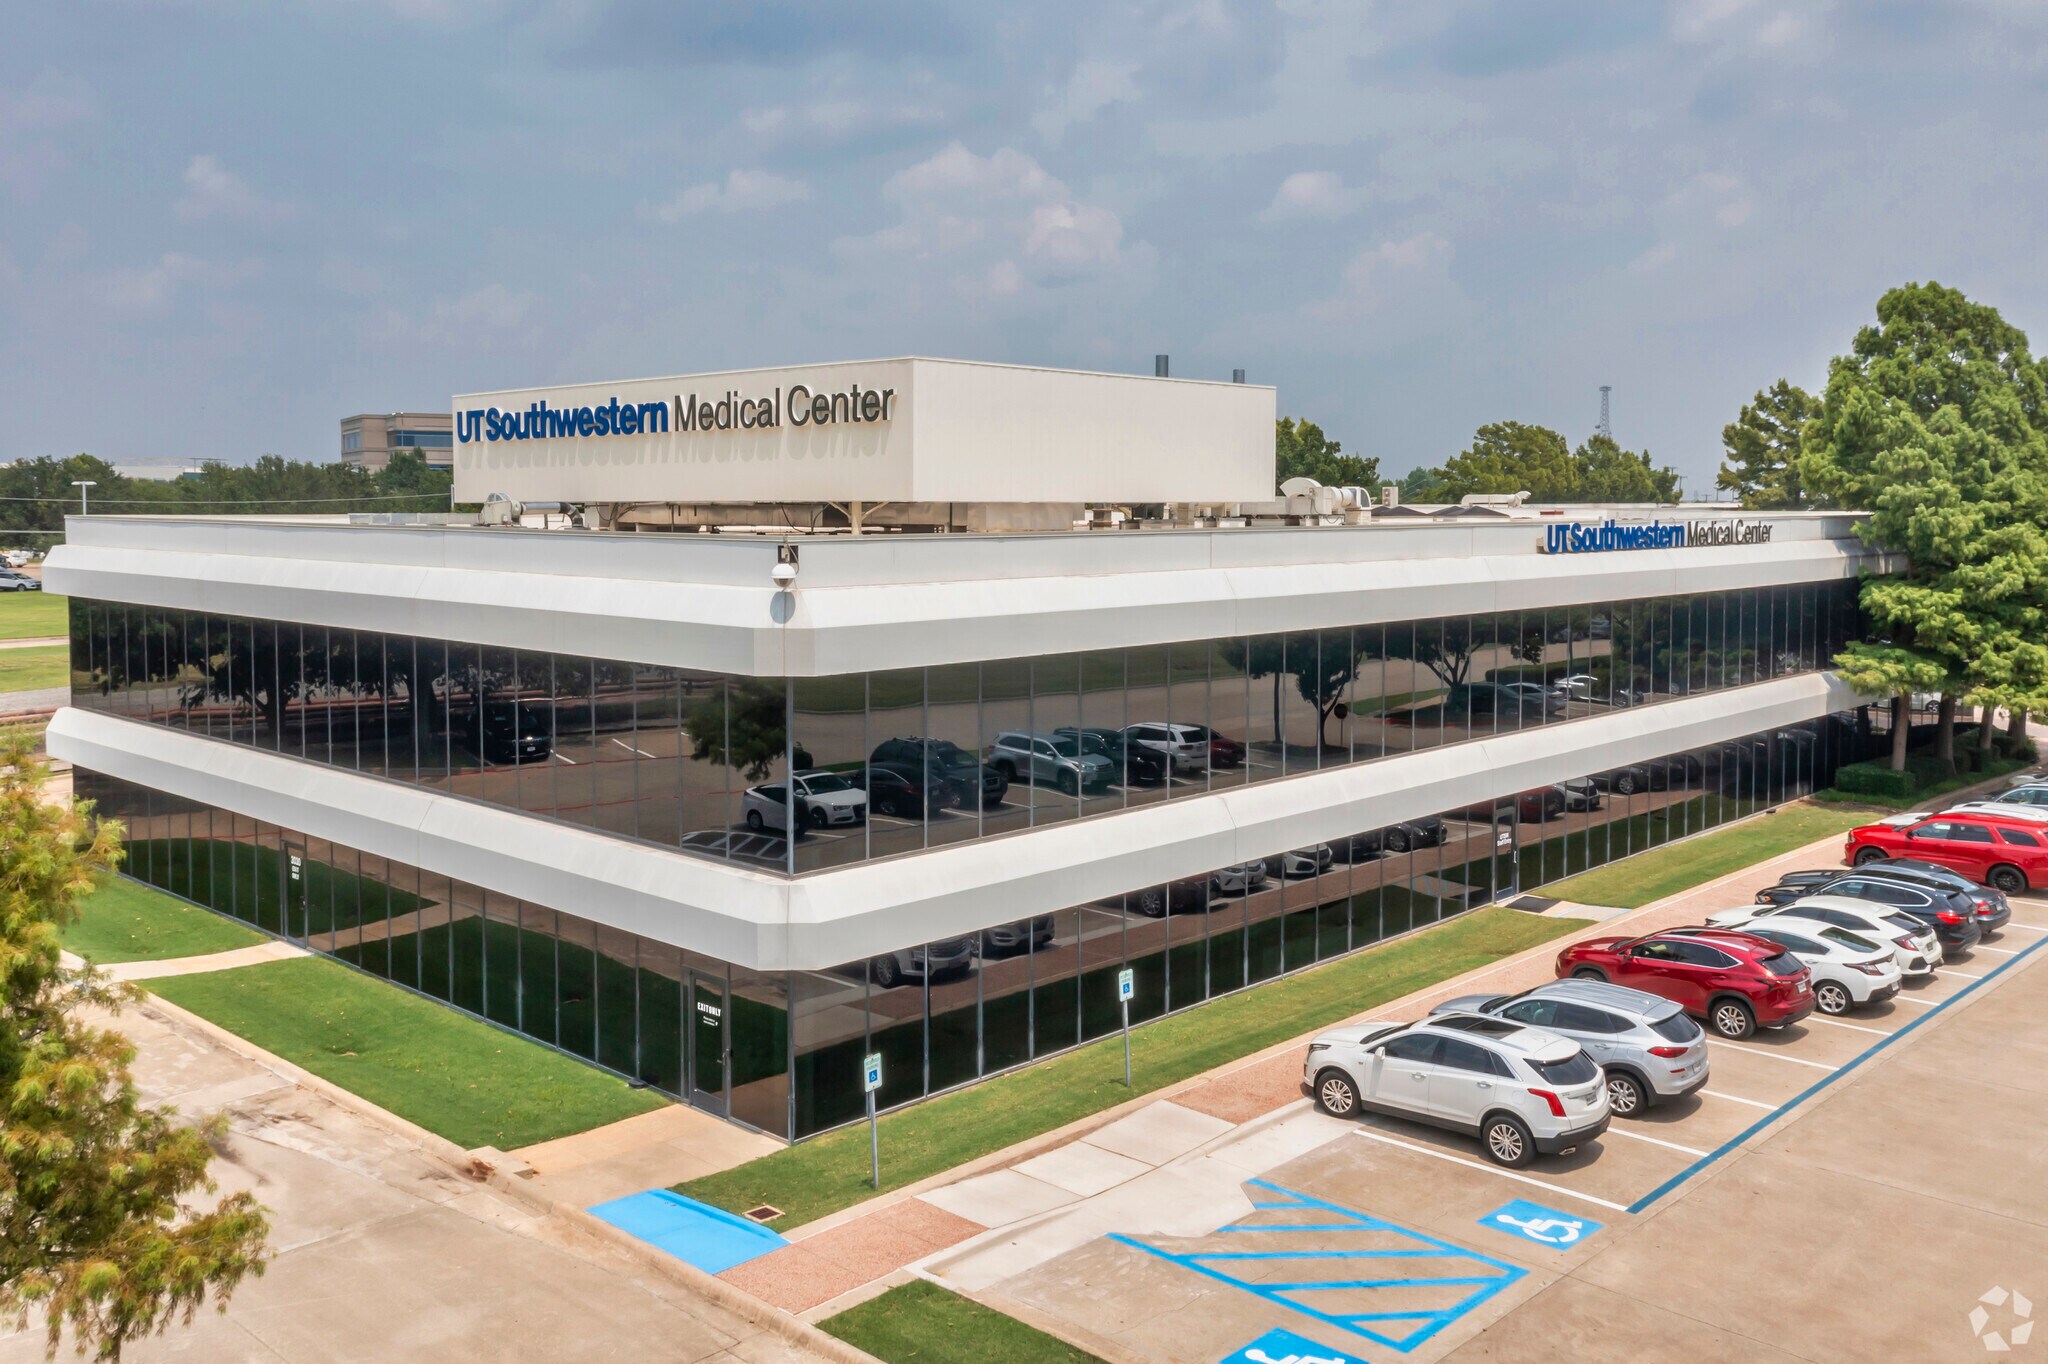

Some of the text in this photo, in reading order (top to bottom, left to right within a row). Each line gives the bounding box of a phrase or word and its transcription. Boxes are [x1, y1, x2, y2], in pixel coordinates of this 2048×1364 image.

[674, 387, 780, 432] Medical
[787, 384, 894, 427] Center
[1687, 520, 1734, 546] Medical
[1735, 519, 1773, 543] Center
